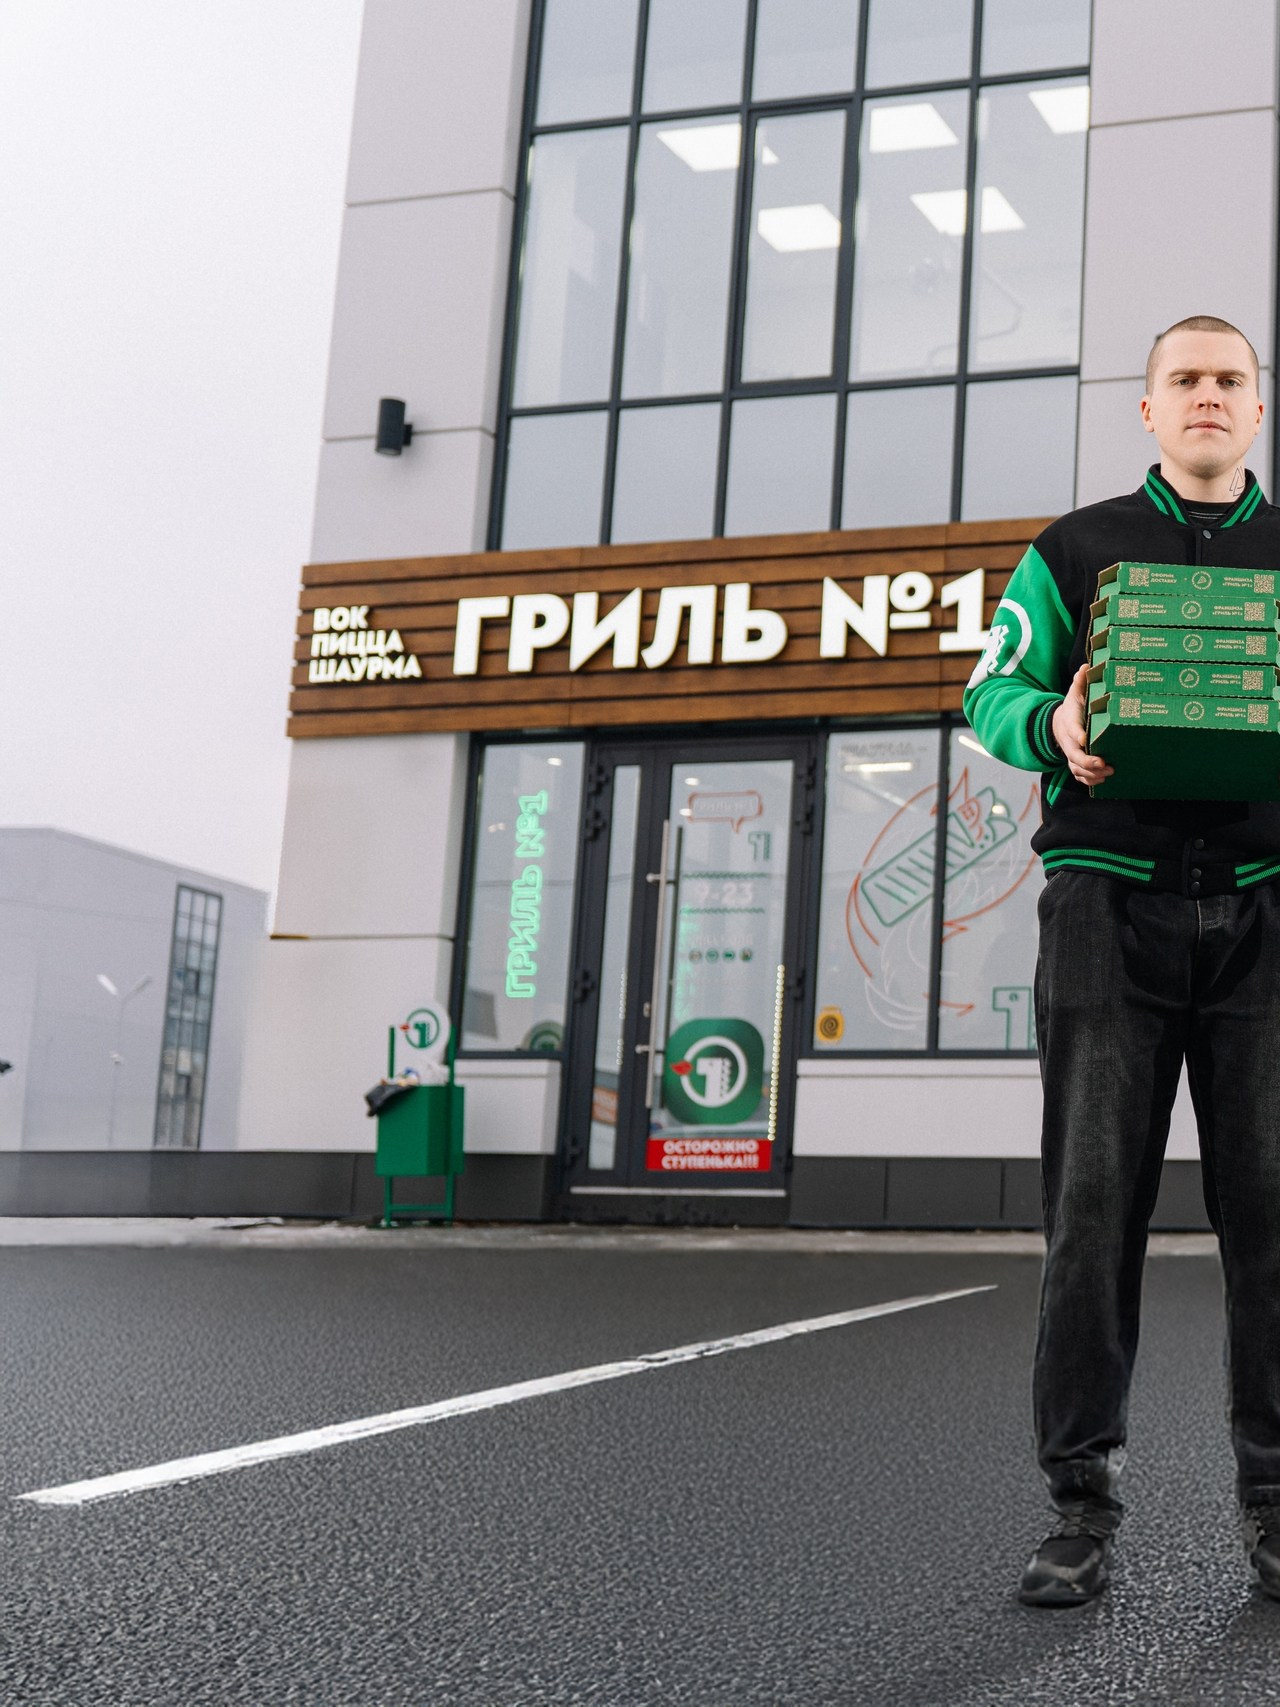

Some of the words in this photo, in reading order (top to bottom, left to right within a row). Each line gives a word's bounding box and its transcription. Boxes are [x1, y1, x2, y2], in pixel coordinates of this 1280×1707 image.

[313, 605, 369, 632] ВОК
[453, 583, 788, 676] ГРИЛЬ
[820, 567, 991, 658] №1
[310, 629, 404, 658] ПИЦЦА
[308, 654, 422, 683] ШАУРМА
[514, 789, 549, 858] №1
[505, 864, 544, 998] ГРИЛЬ
[662, 1140, 760, 1154] ОСТОРОЖНО
[660, 1154, 760, 1170] СТУПЕНЬКА!!!
